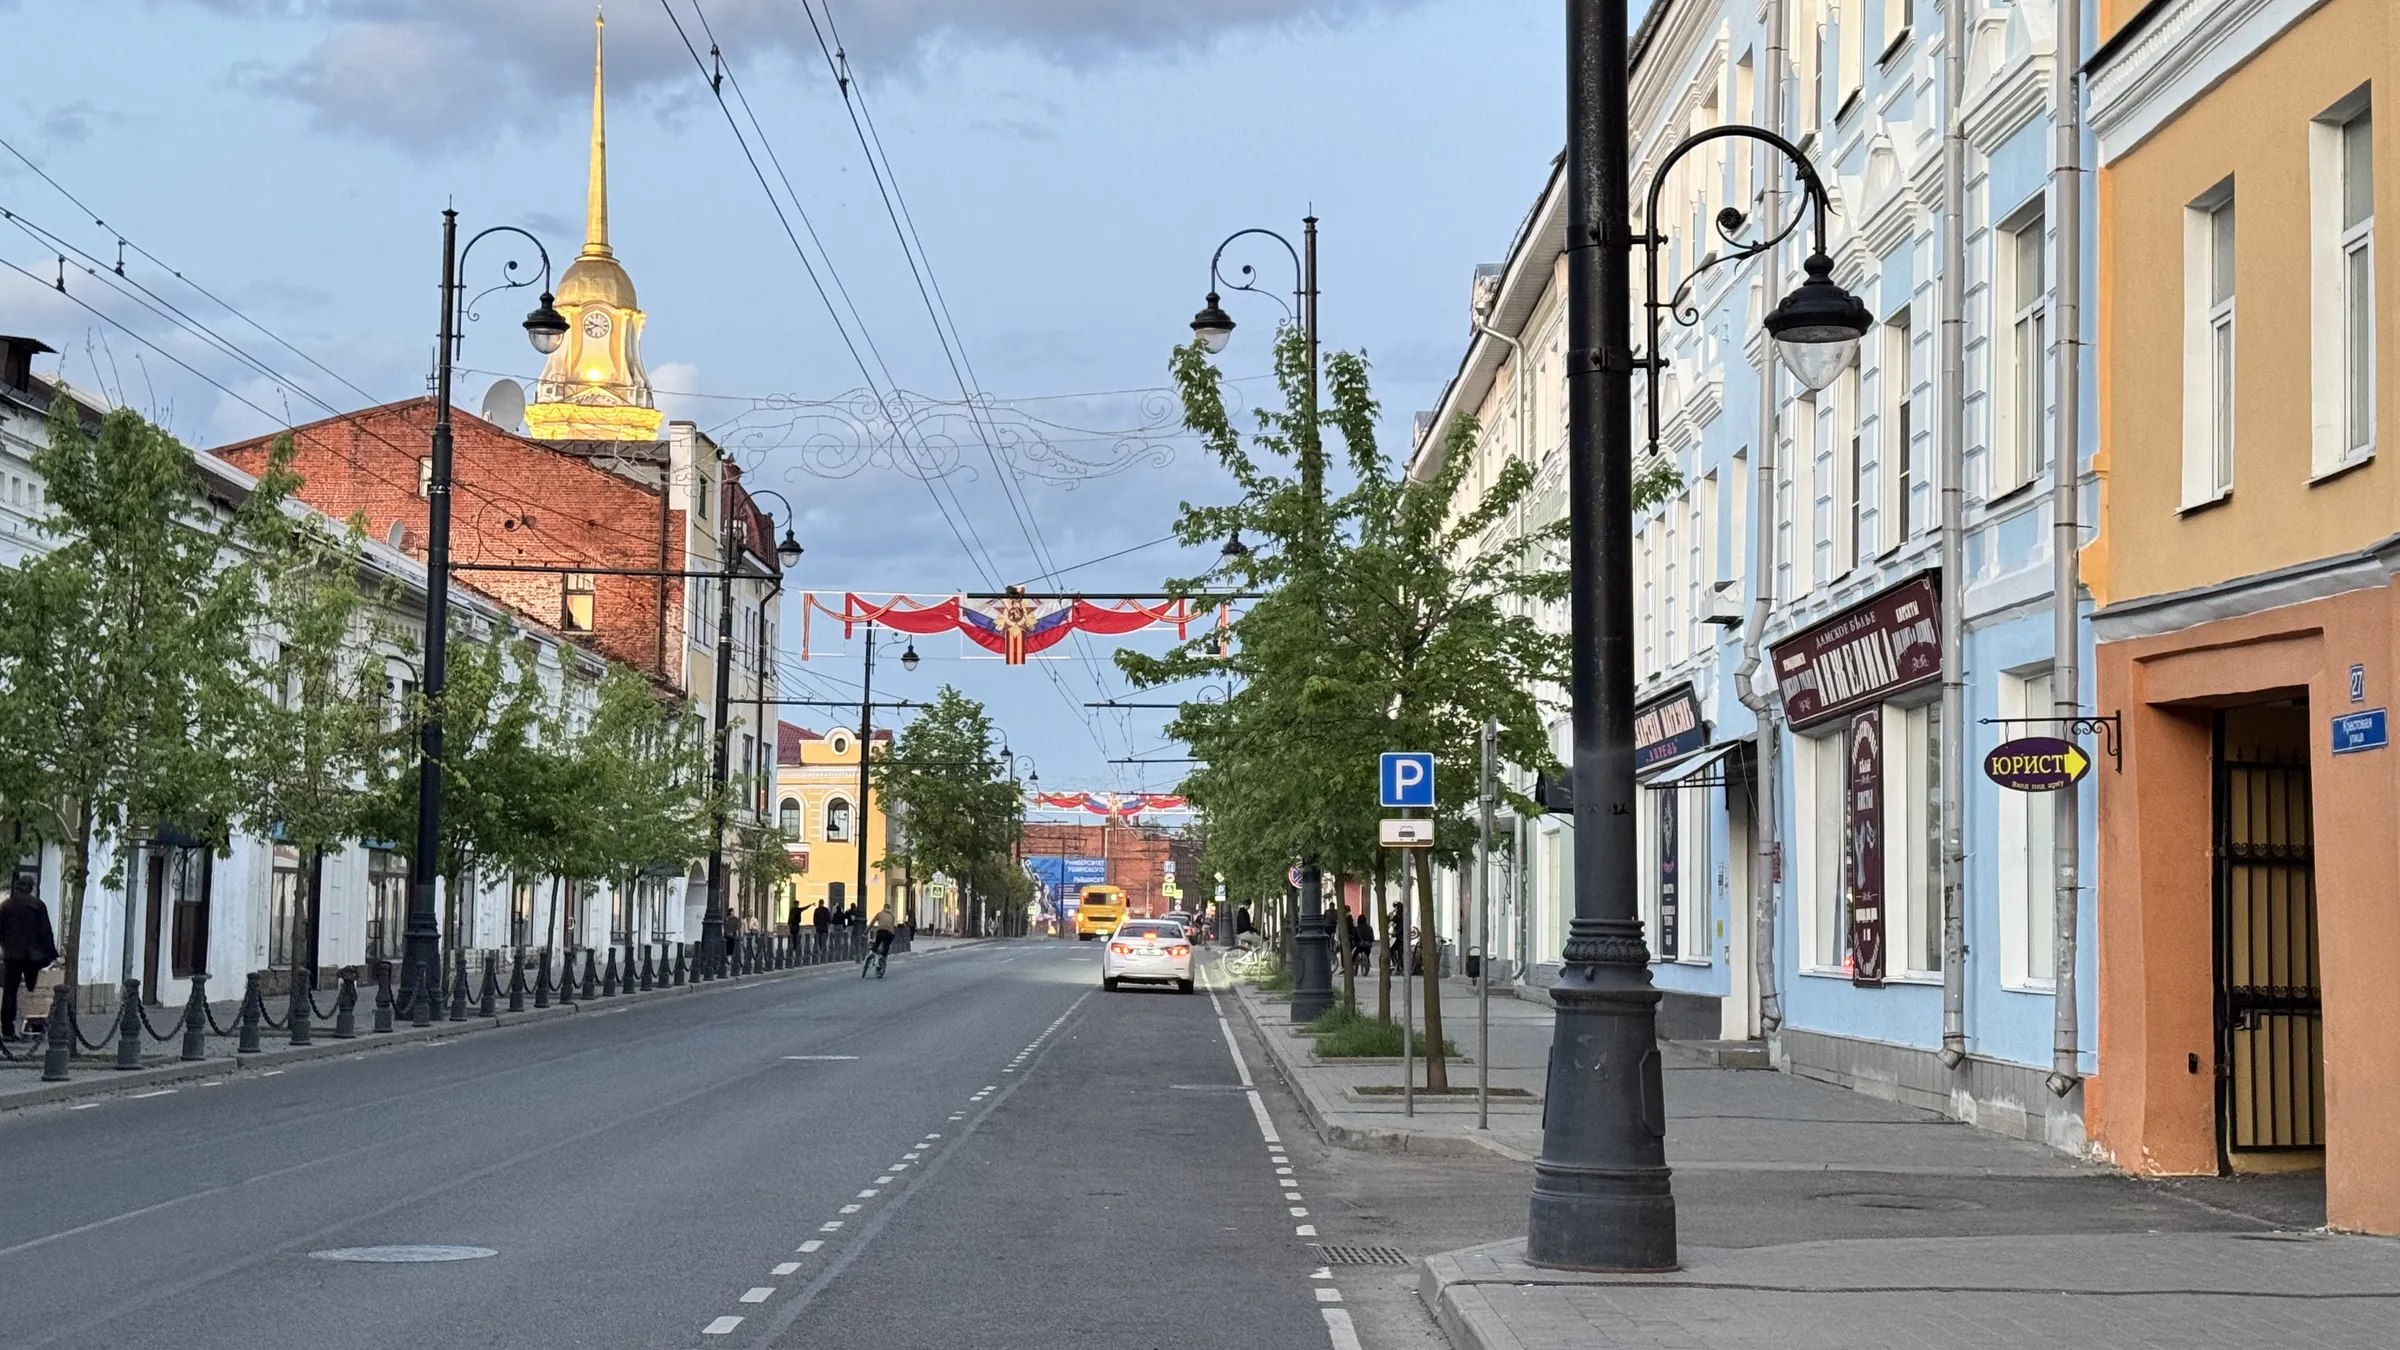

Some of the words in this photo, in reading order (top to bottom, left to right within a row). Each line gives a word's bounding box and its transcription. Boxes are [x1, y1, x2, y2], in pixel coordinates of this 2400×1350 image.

[1815, 623, 1849, 650] ДАМСКОЕ
[1813, 628, 1899, 706] АНЖЕЛИКА
[2352, 671, 2363, 695] 27
[2349, 732, 2365, 746] улица
[1992, 755, 2063, 775] ЮРИСТ
[1395, 759, 1424, 800] P
[2012, 781, 2029, 789] Вход
